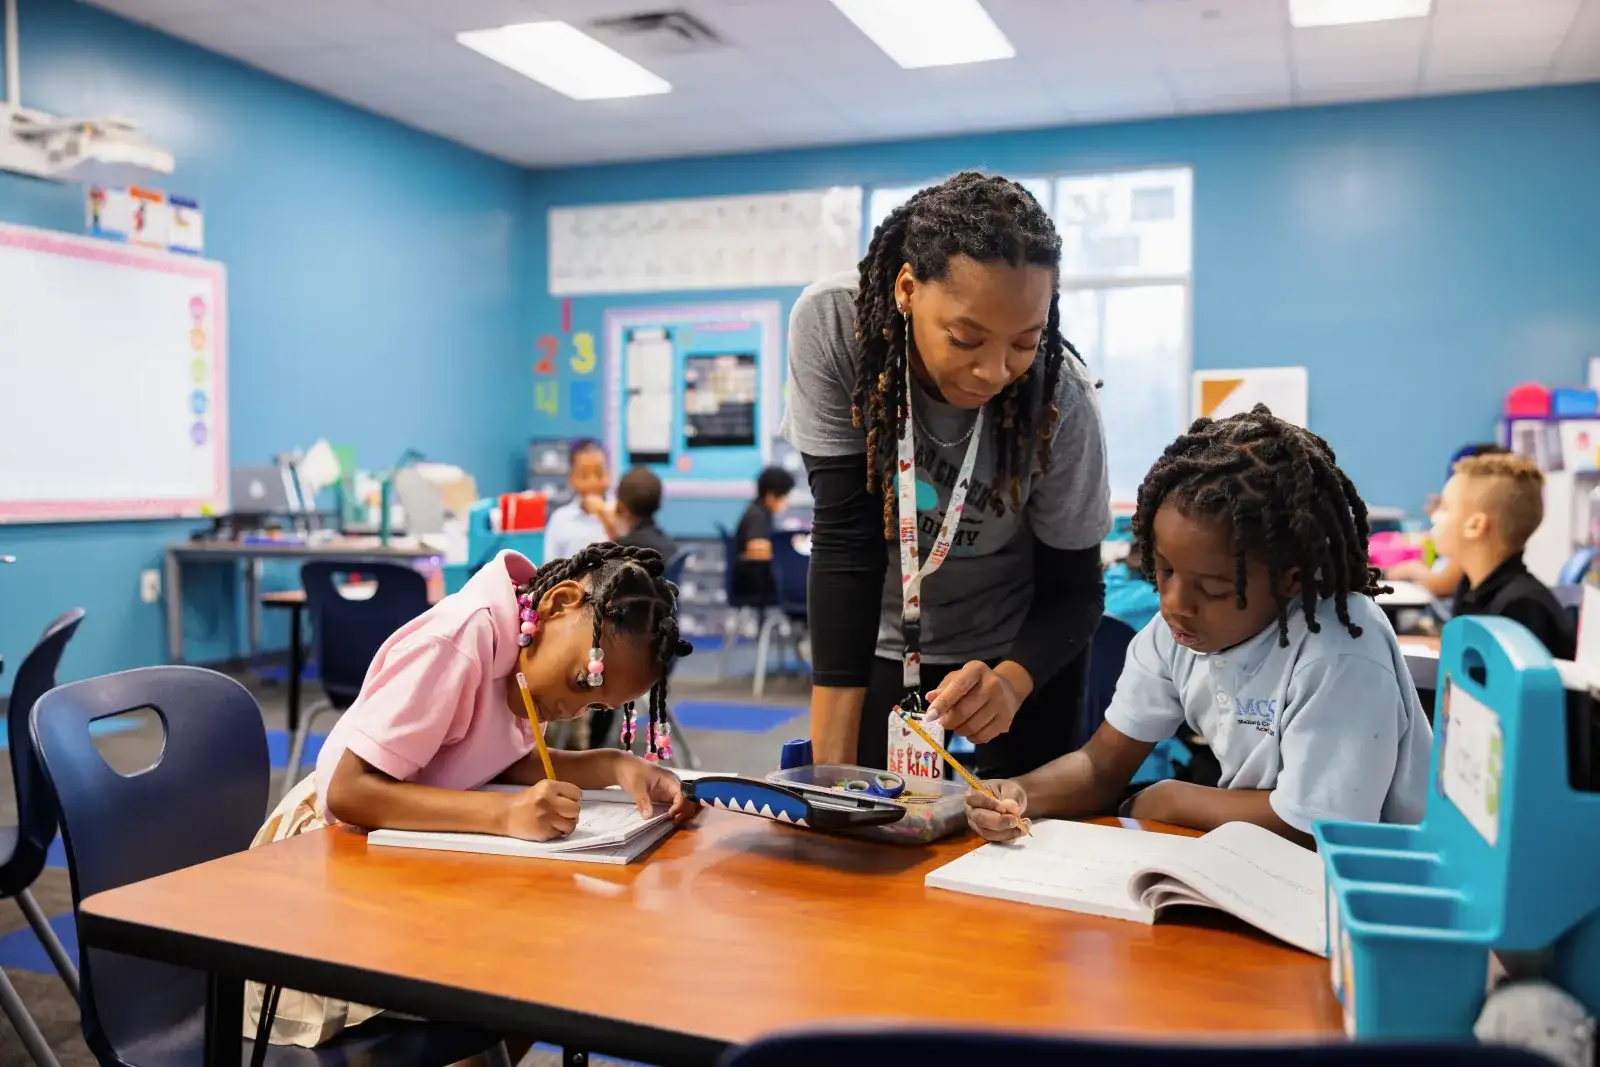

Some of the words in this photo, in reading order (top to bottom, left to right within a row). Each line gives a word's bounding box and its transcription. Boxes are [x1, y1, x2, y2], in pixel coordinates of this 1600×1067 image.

[534, 335, 559, 375] 2
[571, 333, 596, 374] 3
[534, 381, 559, 418] 4
[570, 381, 595, 421] 5
